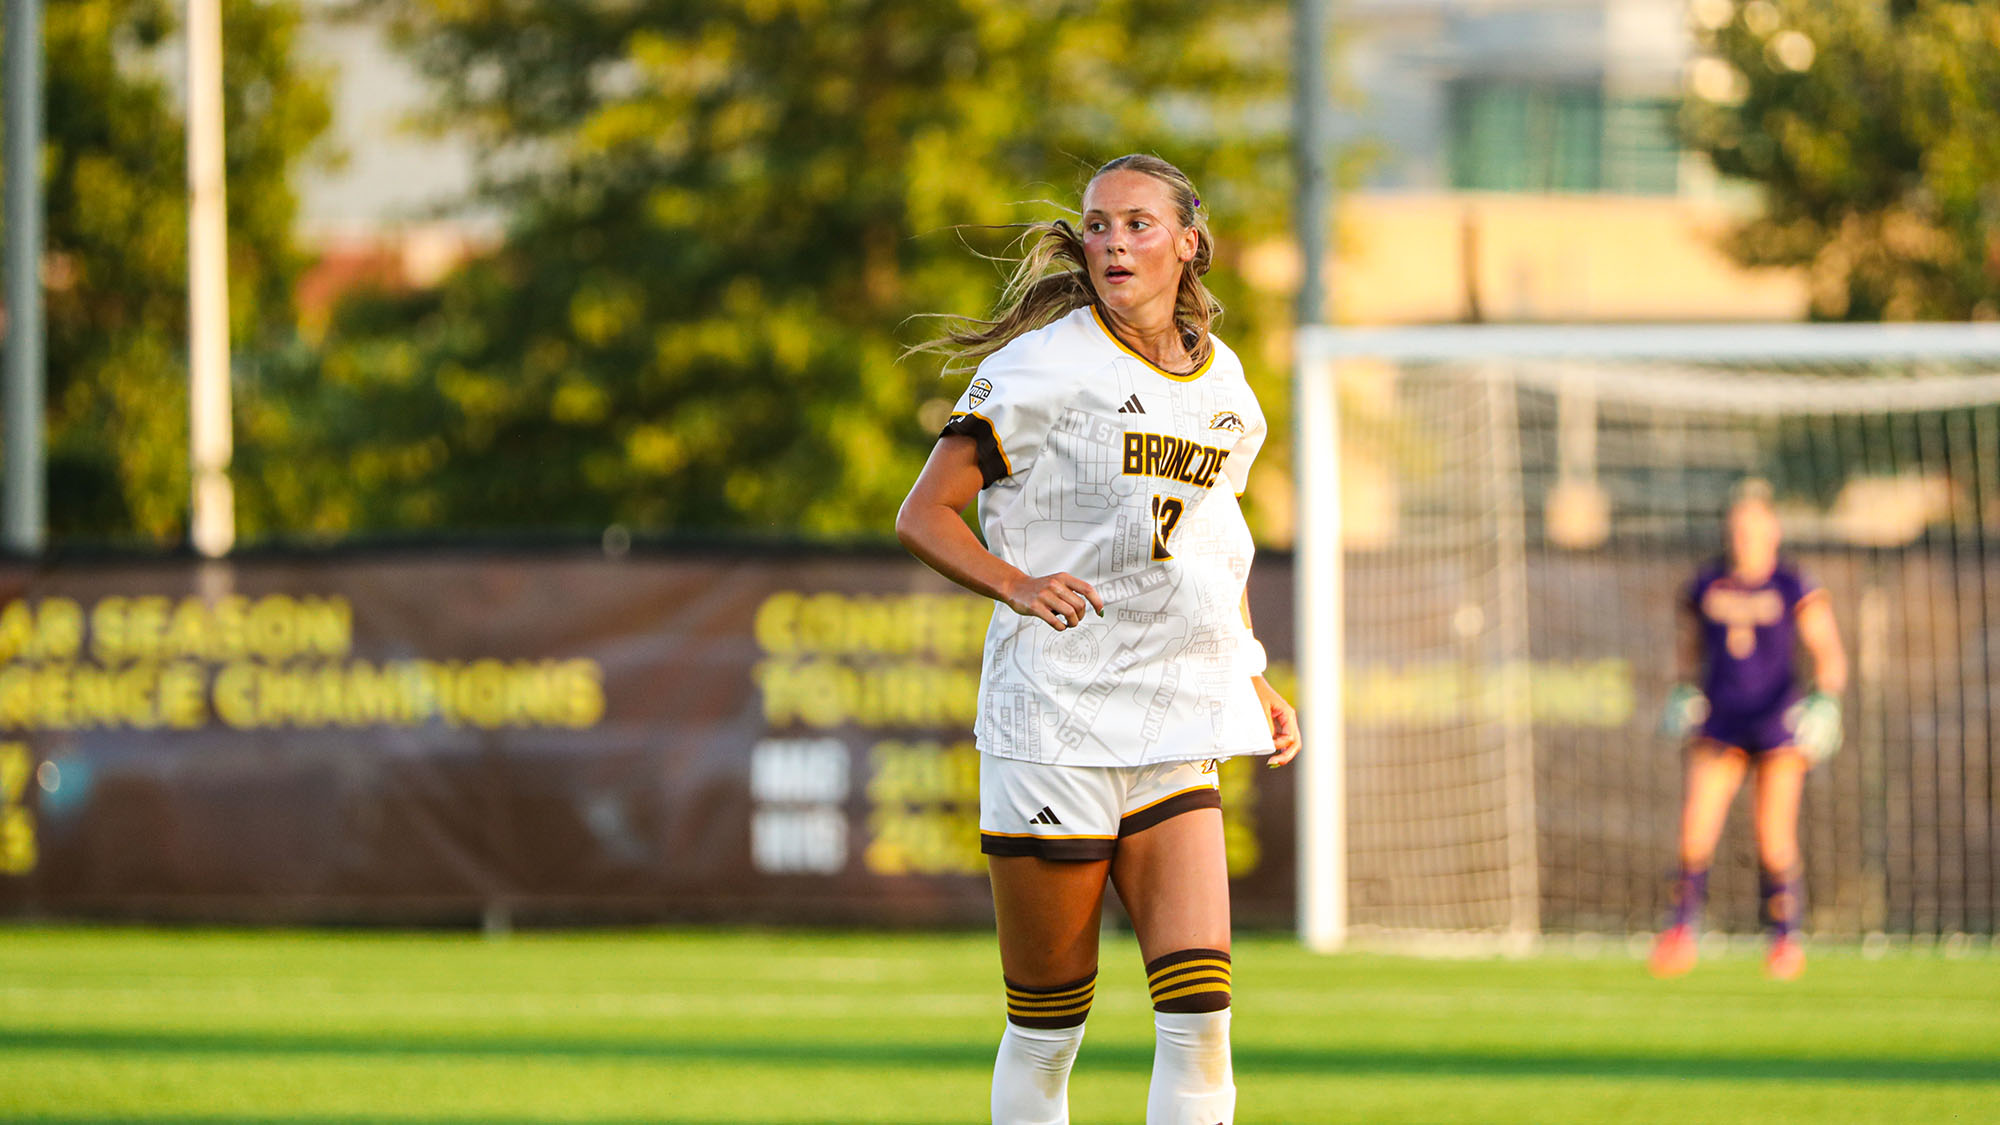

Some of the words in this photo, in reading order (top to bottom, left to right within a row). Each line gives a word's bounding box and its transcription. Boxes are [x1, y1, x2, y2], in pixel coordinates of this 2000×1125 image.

[969, 386, 990, 400] MAC
[1096, 422, 1121, 446] ST
[1123, 432, 1230, 488] BRONCOS
[1141, 569, 1166, 589] AVE
[92, 594, 353, 661] SEASON
[1118, 610, 1155, 624] OLIVER
[213, 658, 605, 732] CHAMPIONS
[1141, 674, 1177, 741] OAKLAND
